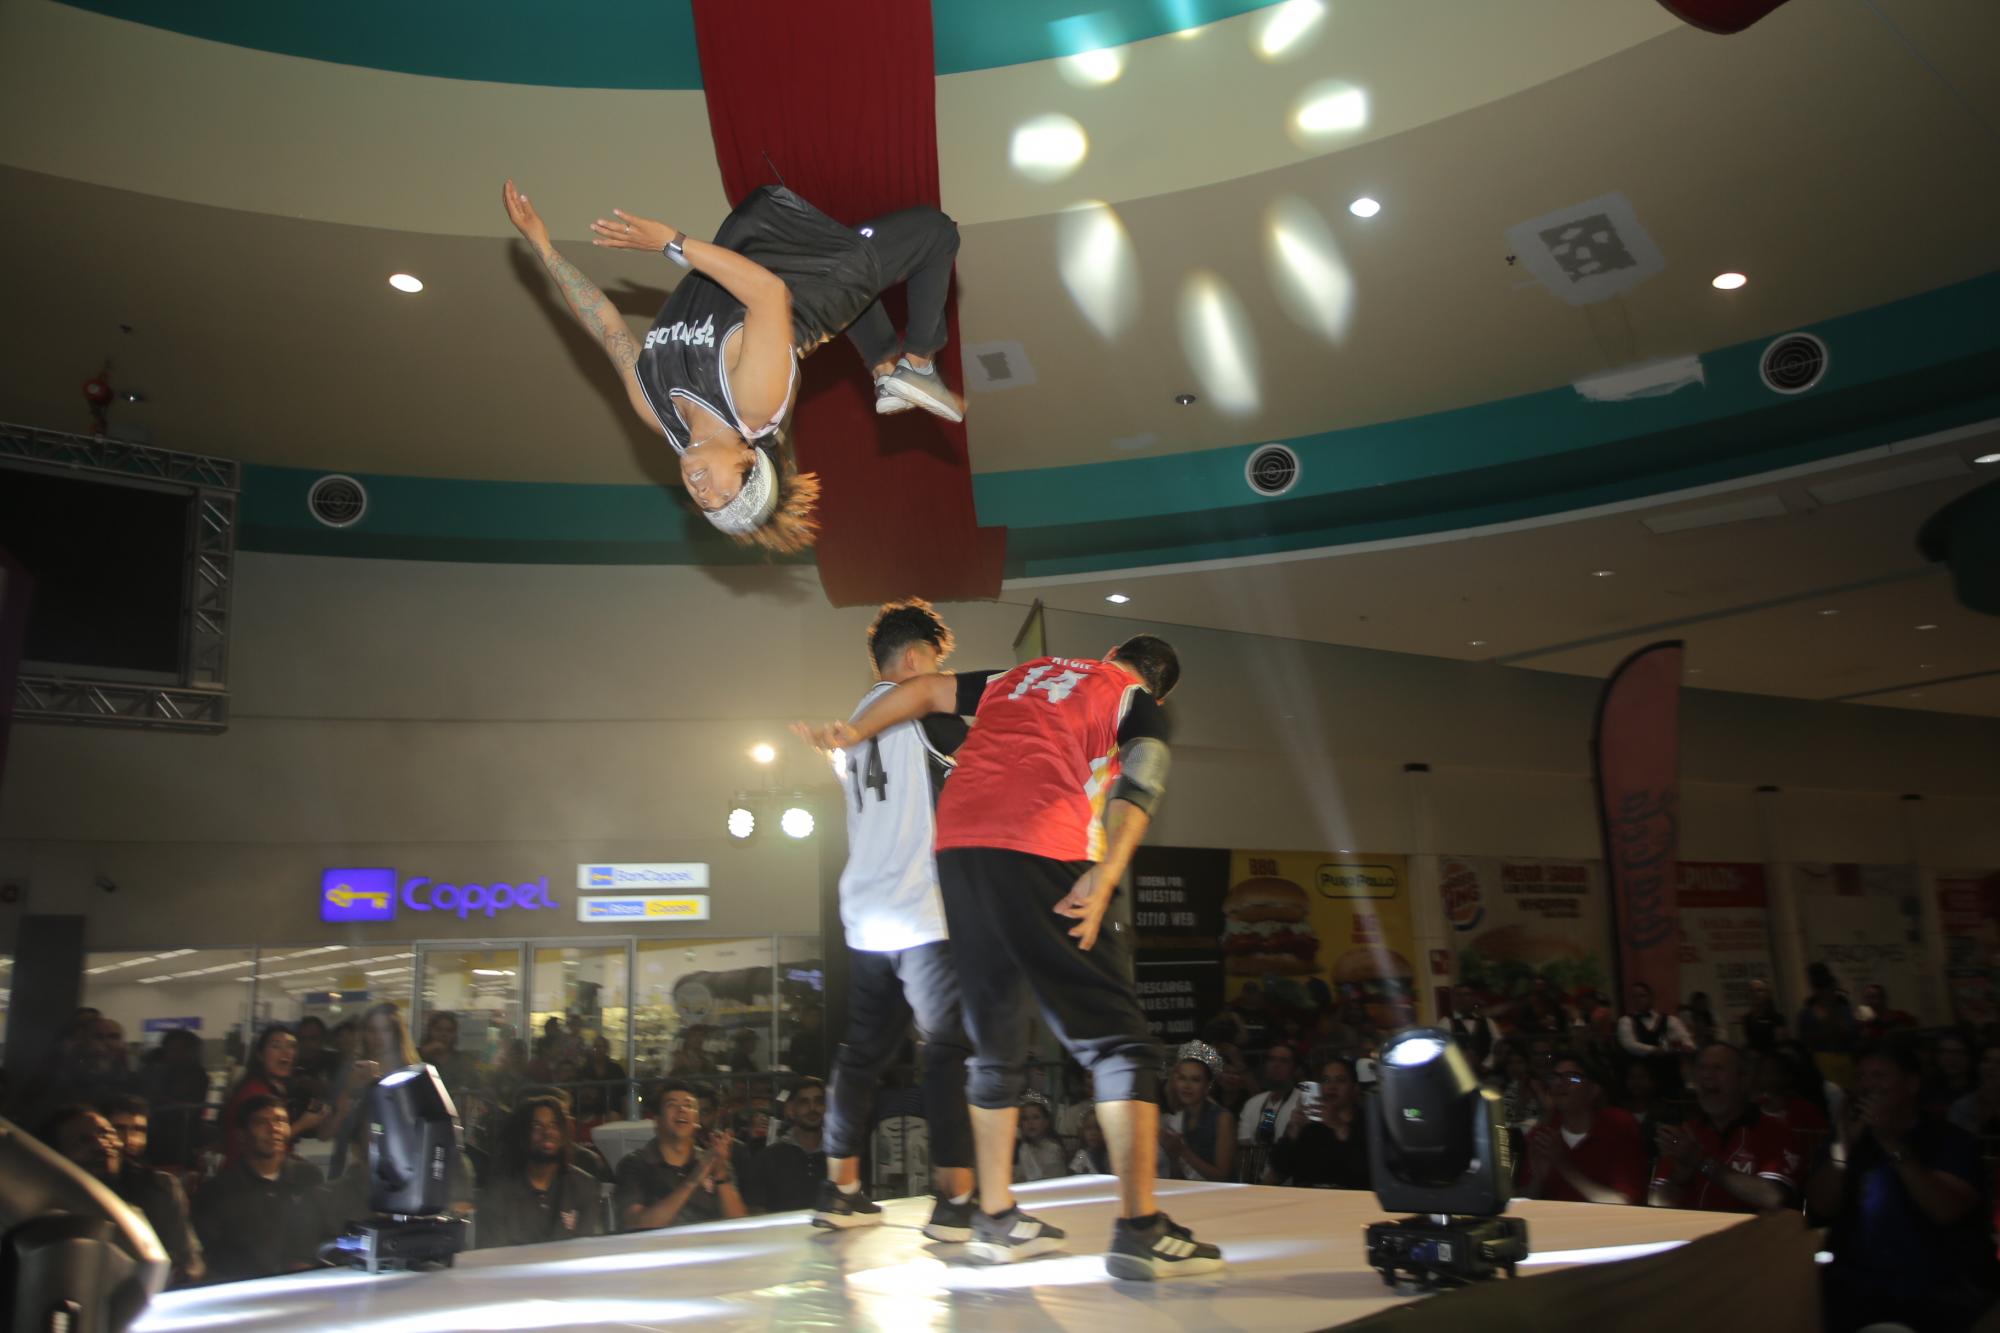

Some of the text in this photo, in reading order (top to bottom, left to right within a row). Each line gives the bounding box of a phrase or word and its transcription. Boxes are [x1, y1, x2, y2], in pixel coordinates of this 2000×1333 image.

[1008, 665, 1089, 704] 14
[847, 734, 888, 812] 14
[403, 876, 559, 919] Coppel
[1137, 890, 1186, 904] NUESTRO
[1136, 911, 1195, 926] SITIO WEB
[1136, 980, 1192, 994] DESCARGA
[1136, 996, 1196, 1011] NUESTRA
